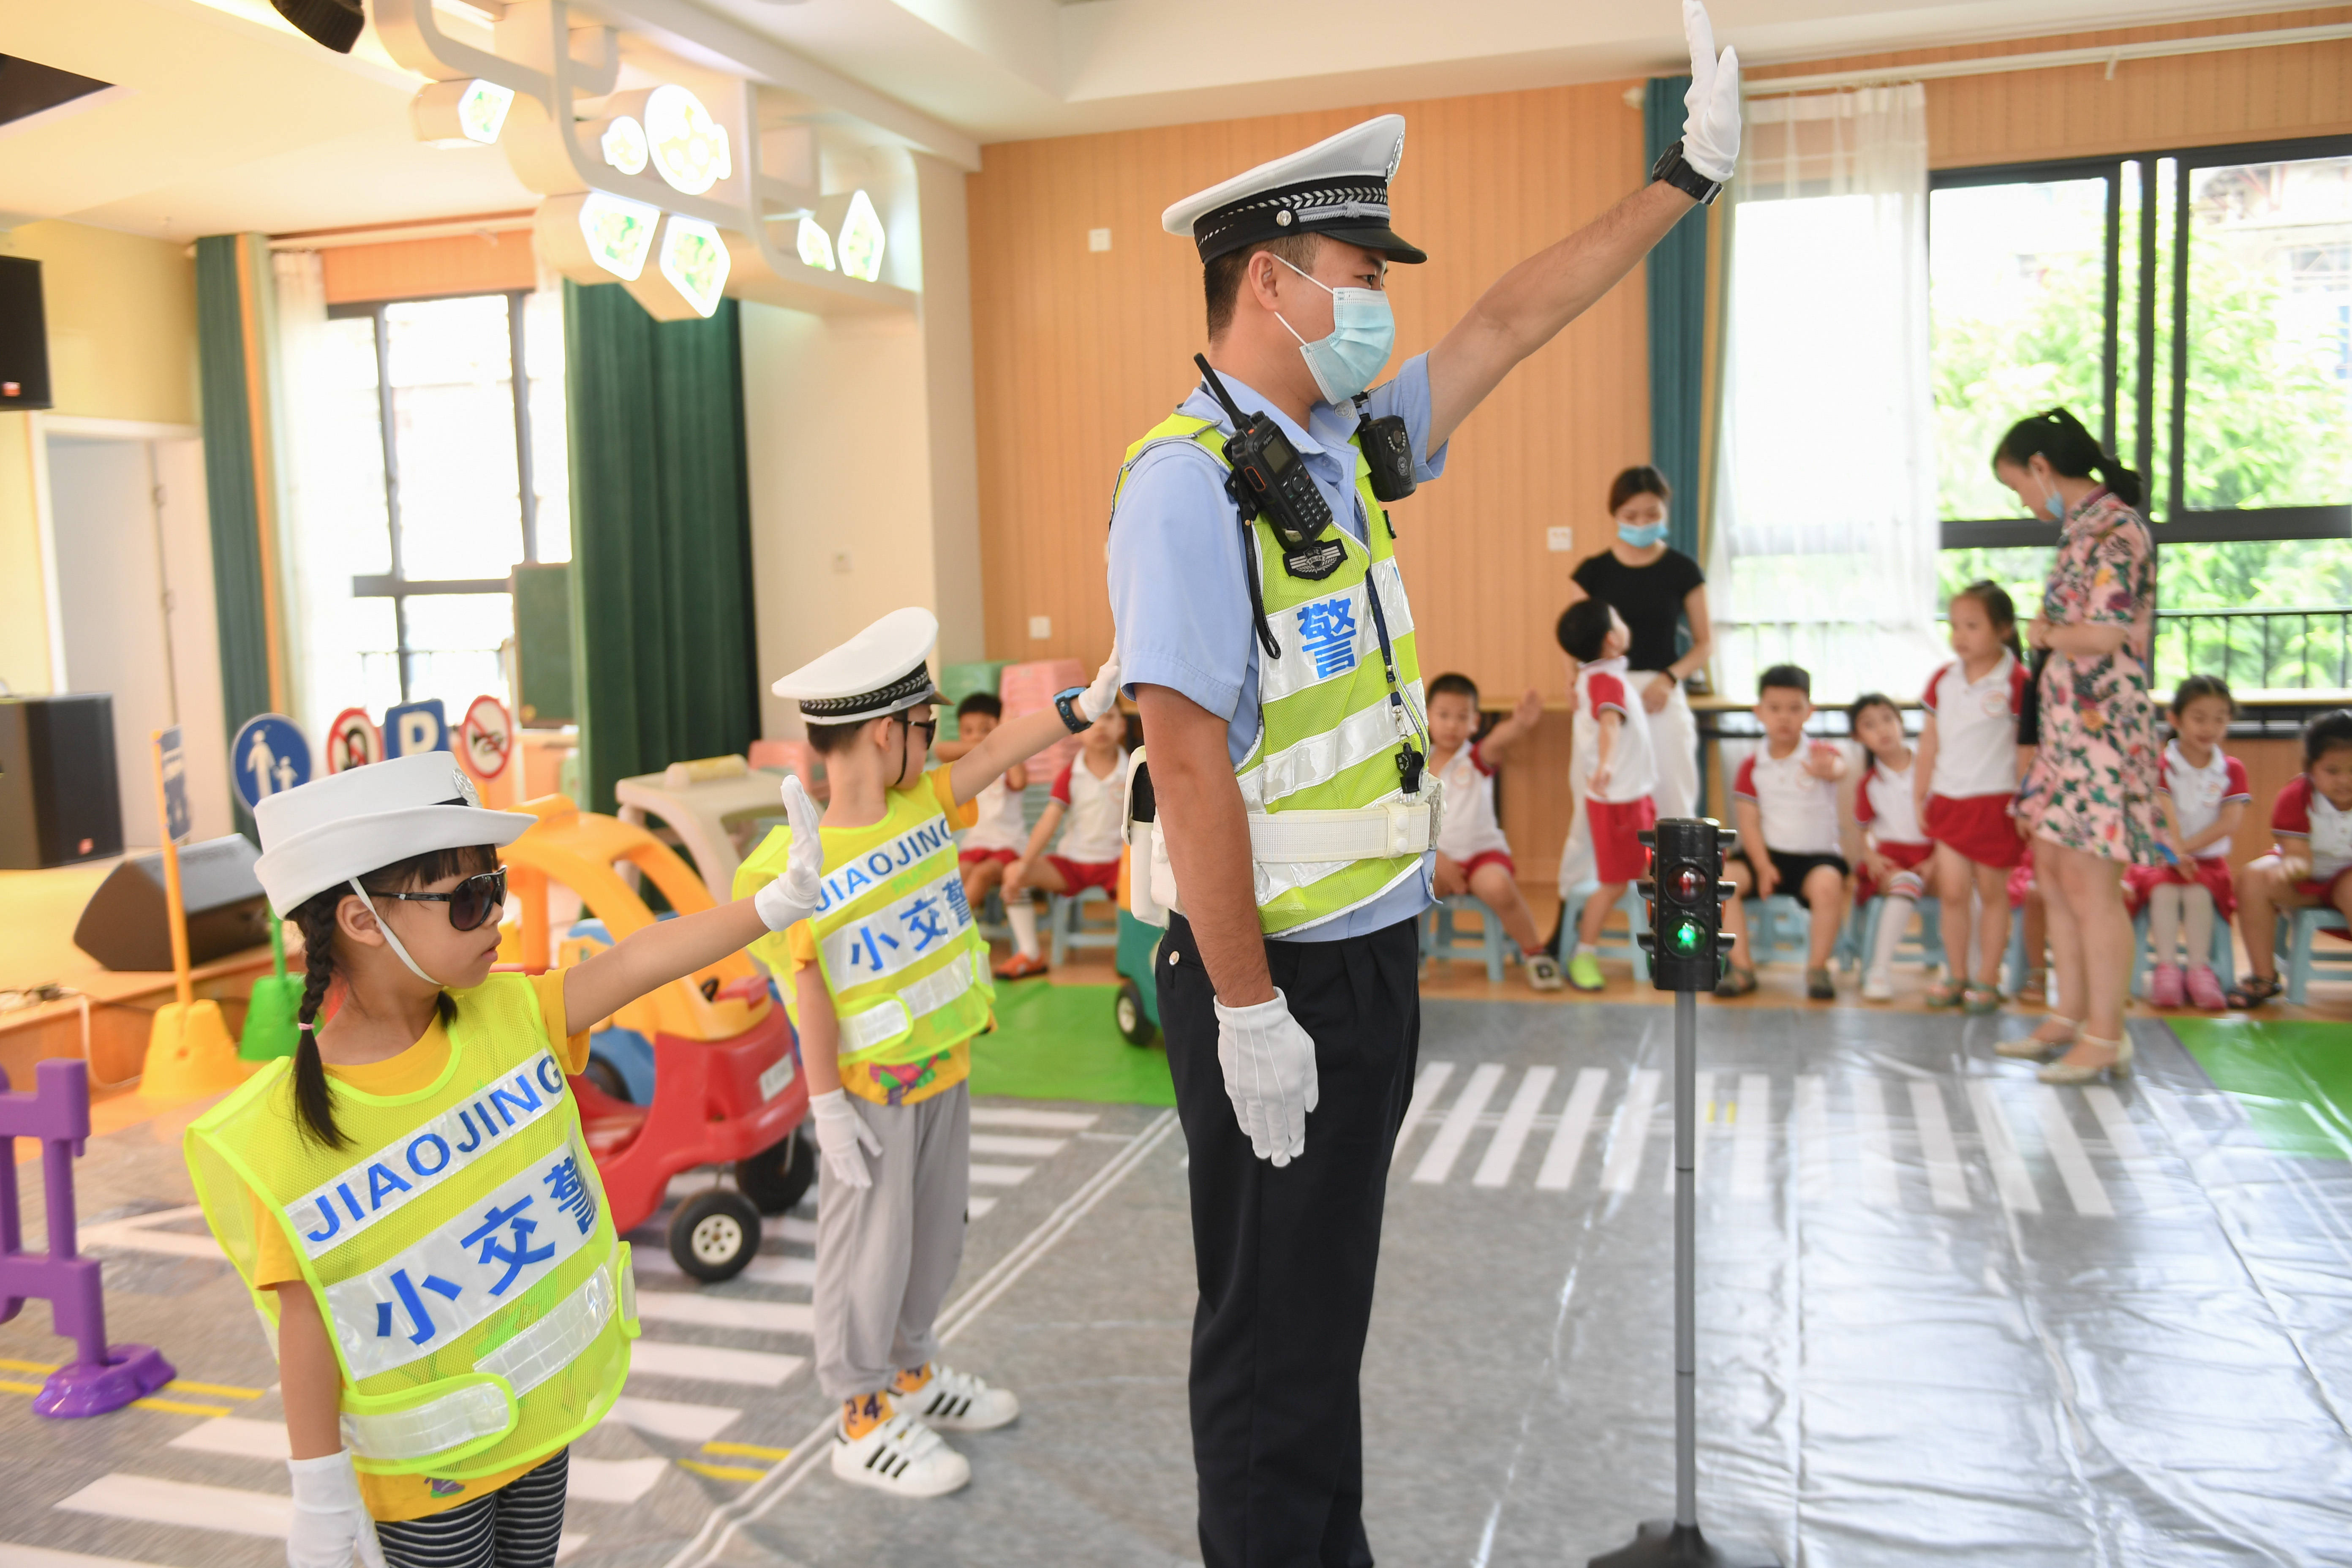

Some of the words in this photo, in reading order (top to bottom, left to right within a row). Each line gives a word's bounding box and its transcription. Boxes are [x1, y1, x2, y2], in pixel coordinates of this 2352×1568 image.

[1296, 598, 1356, 679] 警
[398, 710, 439, 755] P
[307, 1055, 564, 1242] JIAOJING
[376, 1153, 596, 1345] 小交警
